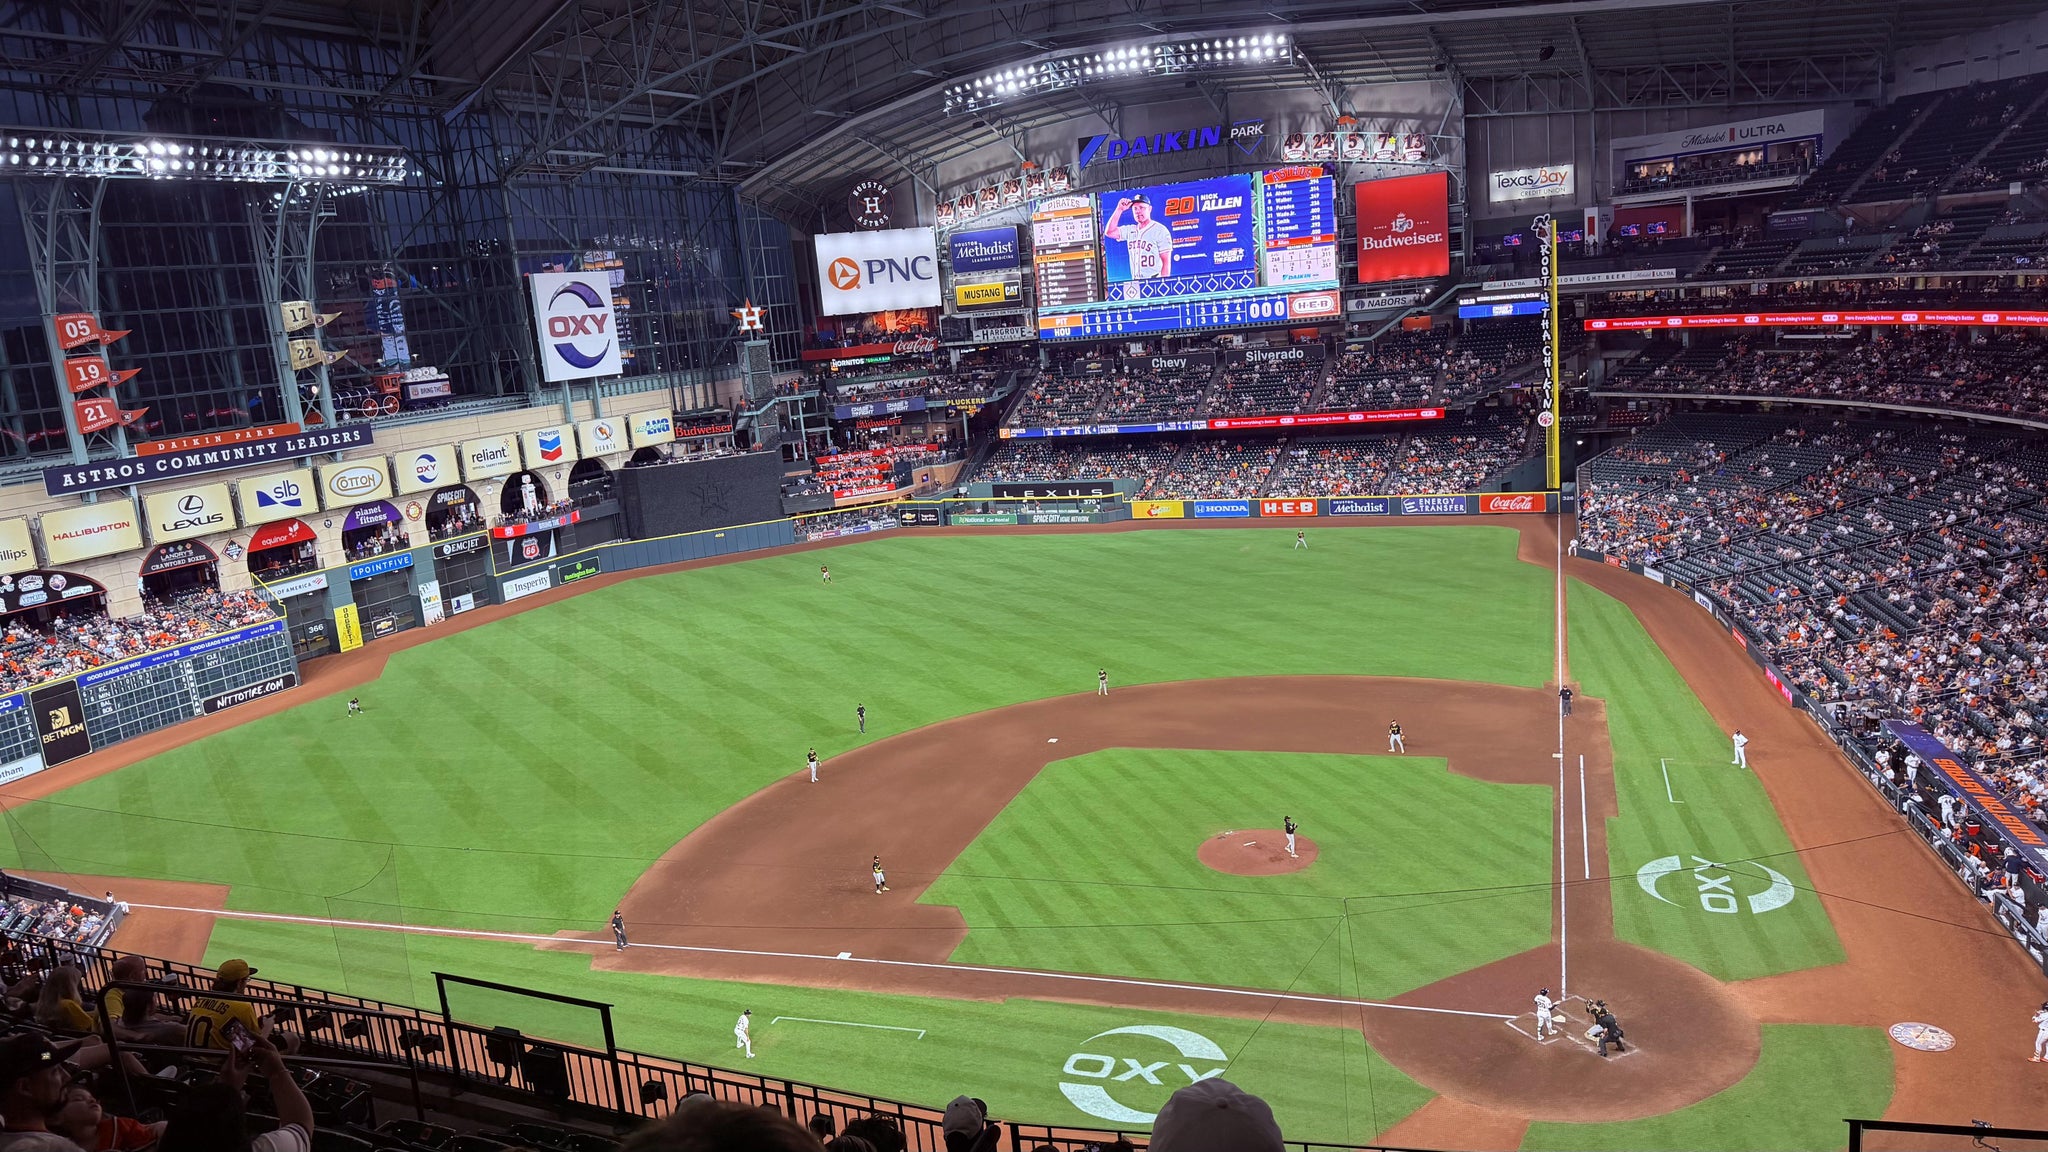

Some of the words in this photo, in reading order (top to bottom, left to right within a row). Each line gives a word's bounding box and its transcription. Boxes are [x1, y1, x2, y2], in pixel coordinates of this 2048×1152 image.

[1231, 123, 1264, 138] PARK
[1681, 131, 1726, 148] Michelob
[1739, 123, 1785, 139] ULTRA
[1107, 126, 1221, 160] DAIKIN
[1284, 133, 1303, 149] 49
[1313, 133, 1331, 149] 24
[1348, 133, 1357, 149] 5
[1379, 133, 1388, 149] 7
[1404, 133, 1424, 149] 13
[1272, 166, 1312, 181] ASTROS
[1495, 174, 1533, 188] Texas
[1539, 169, 1568, 186] Bay
[852, 182, 888, 196] HOUSTON
[1543, 187, 1565, 195] UNION
[864, 197, 881, 213] H
[1048, 199, 1080, 210] PIRATES
[1165, 196, 1194, 216] 20
[1201, 196, 1242, 211] ALLEN
[857, 214, 888, 226] ASTROS
[956, 241, 1013, 259] Methodist
[1141, 255, 1155, 267] 20
[1540, 244, 1549, 287] ROOT
[863, 255, 933, 285] PNC
[1578, 274, 1601, 282] LIGHT
[964, 287, 1000, 299] MUSTANG
[1004, 285, 1018, 296] CAT
[1540, 291, 1550, 302] 4
[1368, 297, 1407, 307] NABORS
[289, 307, 308, 323] 17
[738, 306, 764, 330] H
[1055, 318, 1068, 326] PIT
[65, 320, 91, 338] 05
[548, 313, 608, 337] OXY
[1541, 306, 1551, 341] THA
[66, 333, 99, 347] CHAMPIONS
[982, 327, 1026, 340] HARGROVE
[1054, 328, 1071, 337] HOU
[893, 336, 937, 355] Coca-Cola
[297, 347, 314, 361] 22
[1151, 357, 1187, 371] Chevy
[1245, 348, 1304, 362] Silverado
[832, 359, 864, 367] HORNITOS
[76, 364, 100, 381] 19
[1543, 345, 1552, 410] CHIKIN
[76, 376, 108, 390] CHAMPIONS
[946, 398, 986, 406] PLUCKERS
[84, 404, 107, 422] 21
[83, 418, 113, 431] CHAMPIONS
[646, 417, 671, 435] LNG
[675, 423, 733, 438] Budweiser
[1085, 426, 1092, 434] K
[158, 434, 222, 451] DAIKIN
[235, 427, 274, 441] PARK
[537, 429, 560, 438] Chevron
[63, 462, 146, 488] ASTROS
[156, 443, 277, 471] COMMUNITY
[286, 429, 361, 451] LEADERS
[472, 447, 507, 464] reliant
[838, 451, 873, 462] Budweiser
[416, 463, 437, 475] OXY
[337, 471, 375, 491] COTTON
[274, 480, 300, 498] slb
[436, 490, 453, 504] SPACE
[453, 488, 466, 500] CITY
[852, 485, 888, 496] Budweiser
[1003, 488, 1103, 498] LEXUS
[1333, 501, 1383, 513] Methodist
[1419, 504, 1465, 512] TRANSFER
[1489, 496, 1532, 511] Coca-Cola
[354, 505, 382, 519] planet
[359, 511, 388, 525] fitness
[1033, 514, 1049, 523] SPACE
[1049, 514, 1060, 523] CITY
[162, 513, 224, 532] LEXUS
[52, 521, 131, 542] HALLIBURTON
[261, 533, 288, 547] equinor
[451, 537, 479, 552] EMCJET
[160, 549, 194, 561] LANDRY'S
[525, 546, 537, 555] 66
[151, 560, 186, 571] CRAWFORD
[187, 555, 206, 563] BOXES
[353, 556, 410, 577] 1POINTFIVE
[285, 582, 312, 593] AMERICA
[514, 575, 549, 593] Insperity
[422, 594, 439, 604] WM
[308, 623, 324, 634] 366
[189, 643, 205, 652] GOOD
[205, 640, 221, 648] LEADS
[230, 634, 241, 642] WAY
[206, 653, 217, 661] CLE
[207, 659, 219, 667] NYY
[87, 672, 103, 682] GOOD
[102, 668, 120, 678] LEADS
[120, 664, 130, 672] THE
[130, 661, 141, 670] WAY
[99, 692, 111, 700] MIN
[217, 678, 284, 709] NITTOTIRE.COM
[42, 723, 84, 744] BETMGM
[1932, 758, 1991, 795] ASTROS
[1973, 795, 2047, 846] HOUSTON
[1690, 855, 1738, 914] OXY
[1062, 1053, 1226, 1085] OXY
